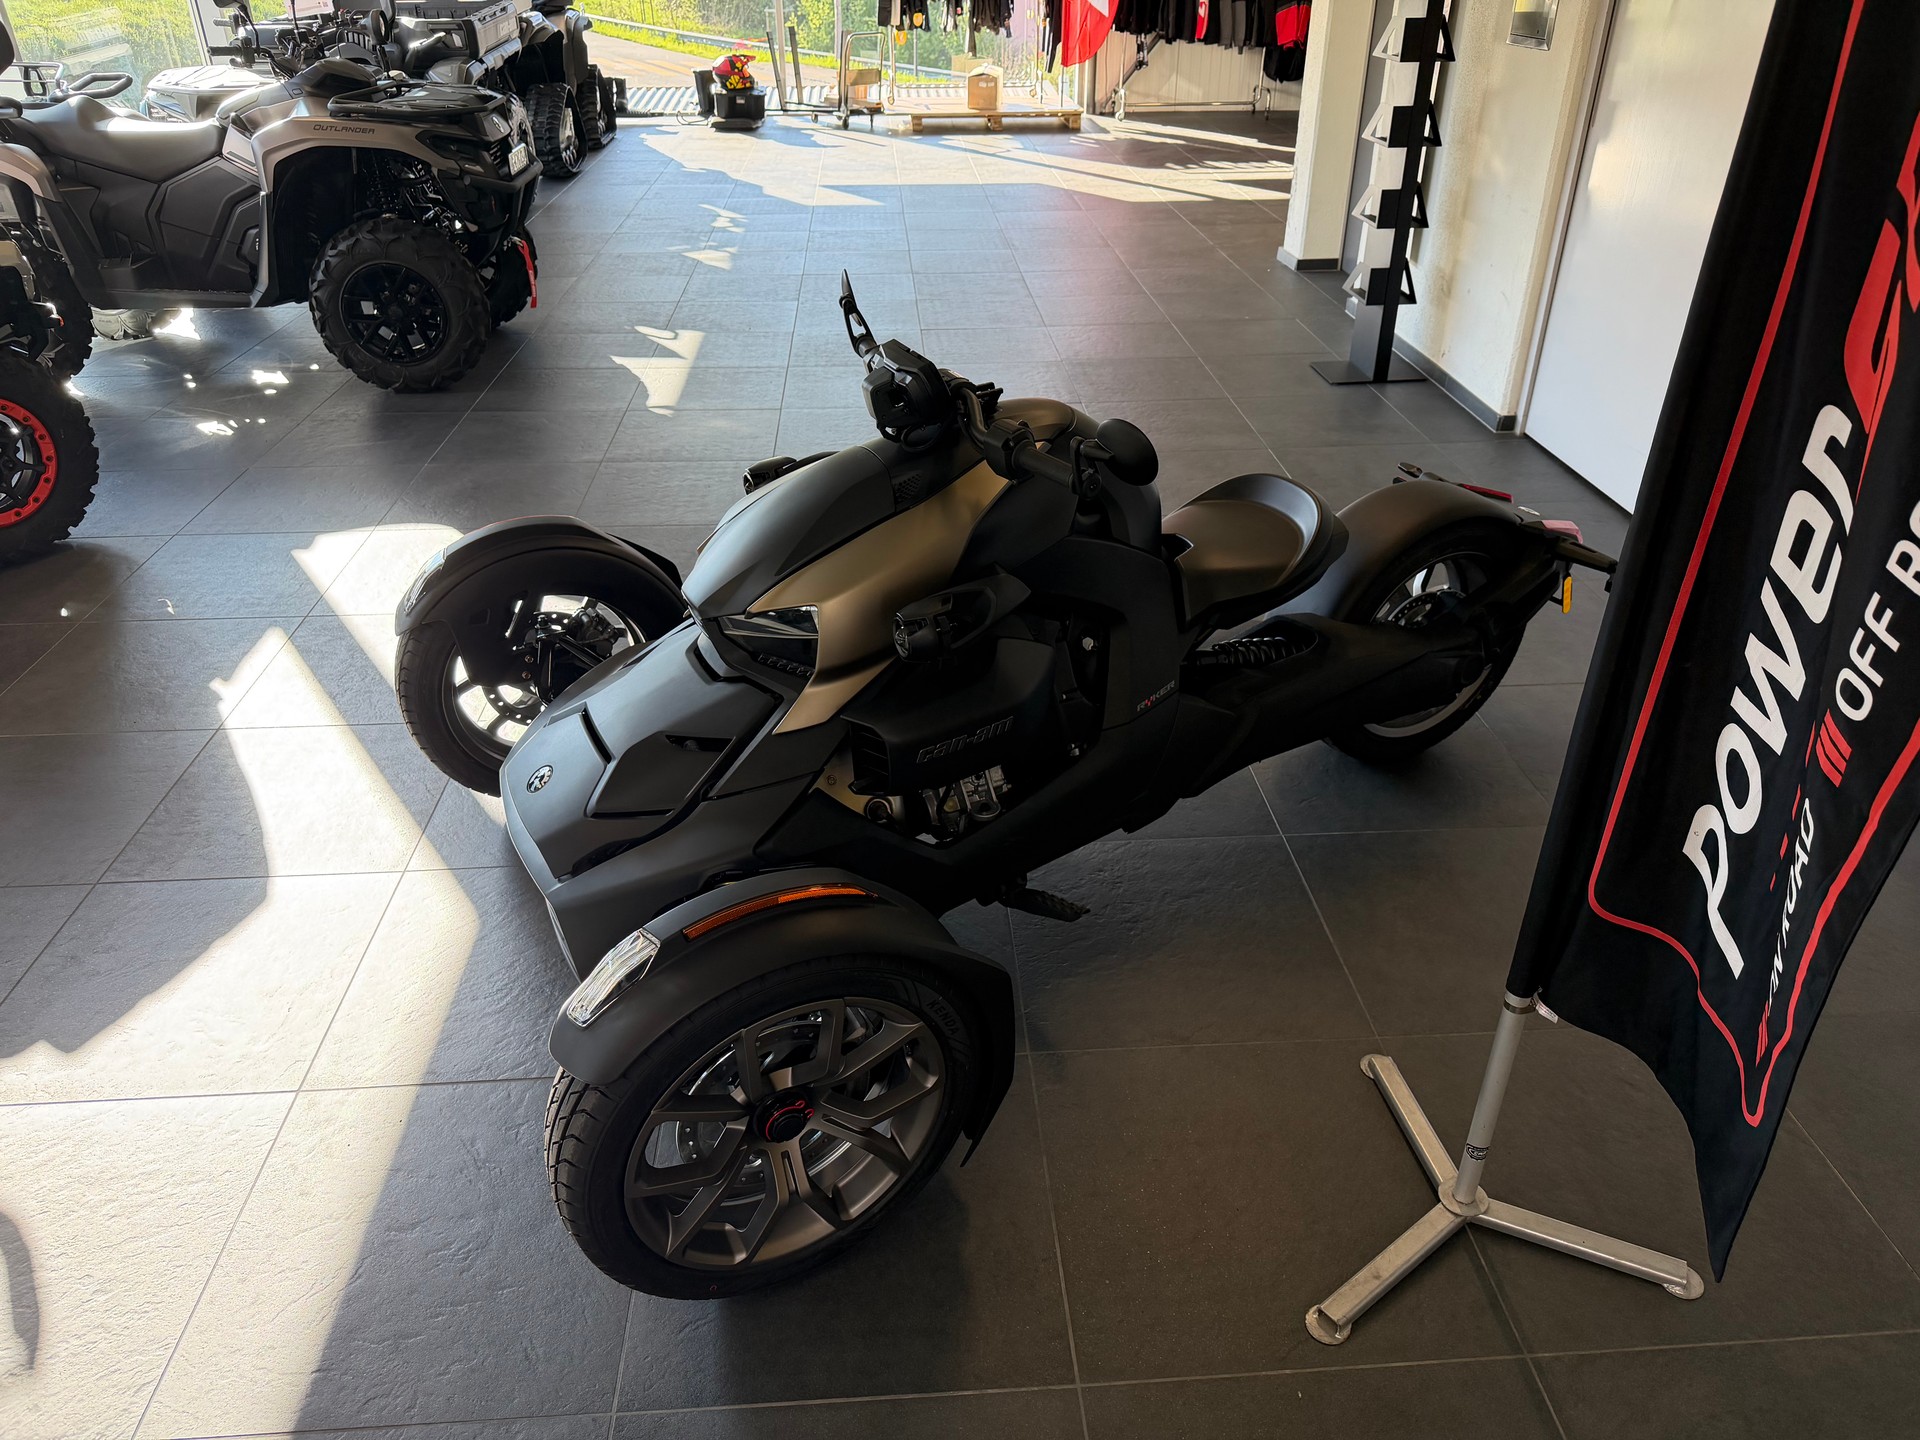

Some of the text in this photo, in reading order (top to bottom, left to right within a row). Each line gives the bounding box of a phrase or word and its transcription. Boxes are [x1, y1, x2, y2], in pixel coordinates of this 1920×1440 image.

[313, 124, 376, 135] OUTLANDER
[1835, 591, 1901, 722] OFF
[1136, 680, 1176, 712] RYKER
[926, 999, 960, 1036] KENDA
